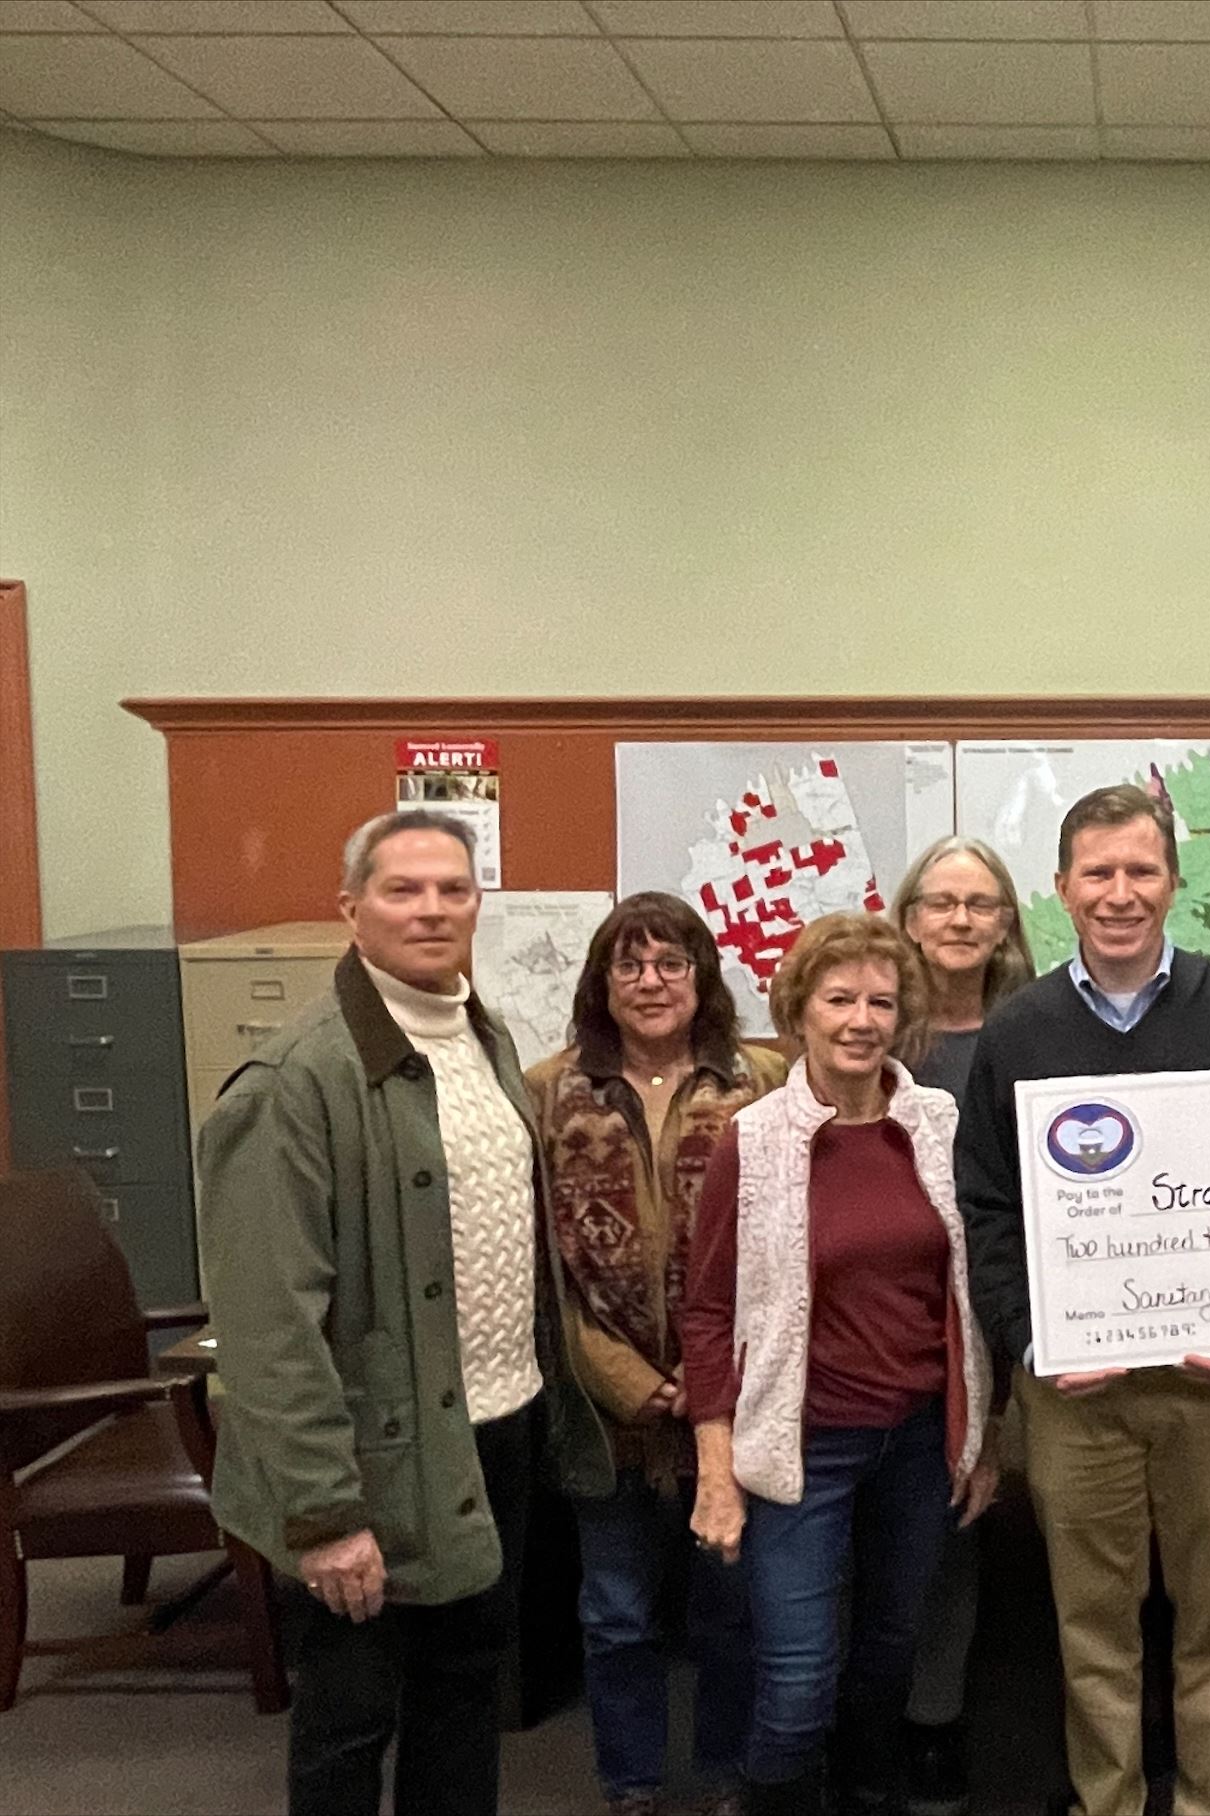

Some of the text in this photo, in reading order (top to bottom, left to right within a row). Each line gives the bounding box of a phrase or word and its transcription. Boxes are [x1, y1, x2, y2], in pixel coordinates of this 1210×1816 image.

[1056, 1186, 1124, 1204] Pay to the
[1067, 1203, 1122, 1219] Order of
[1056, 1233, 1098, 1259] Two
[1106, 1228, 1194, 1258] hundred
[1065, 1309, 1105, 1321] Memo
